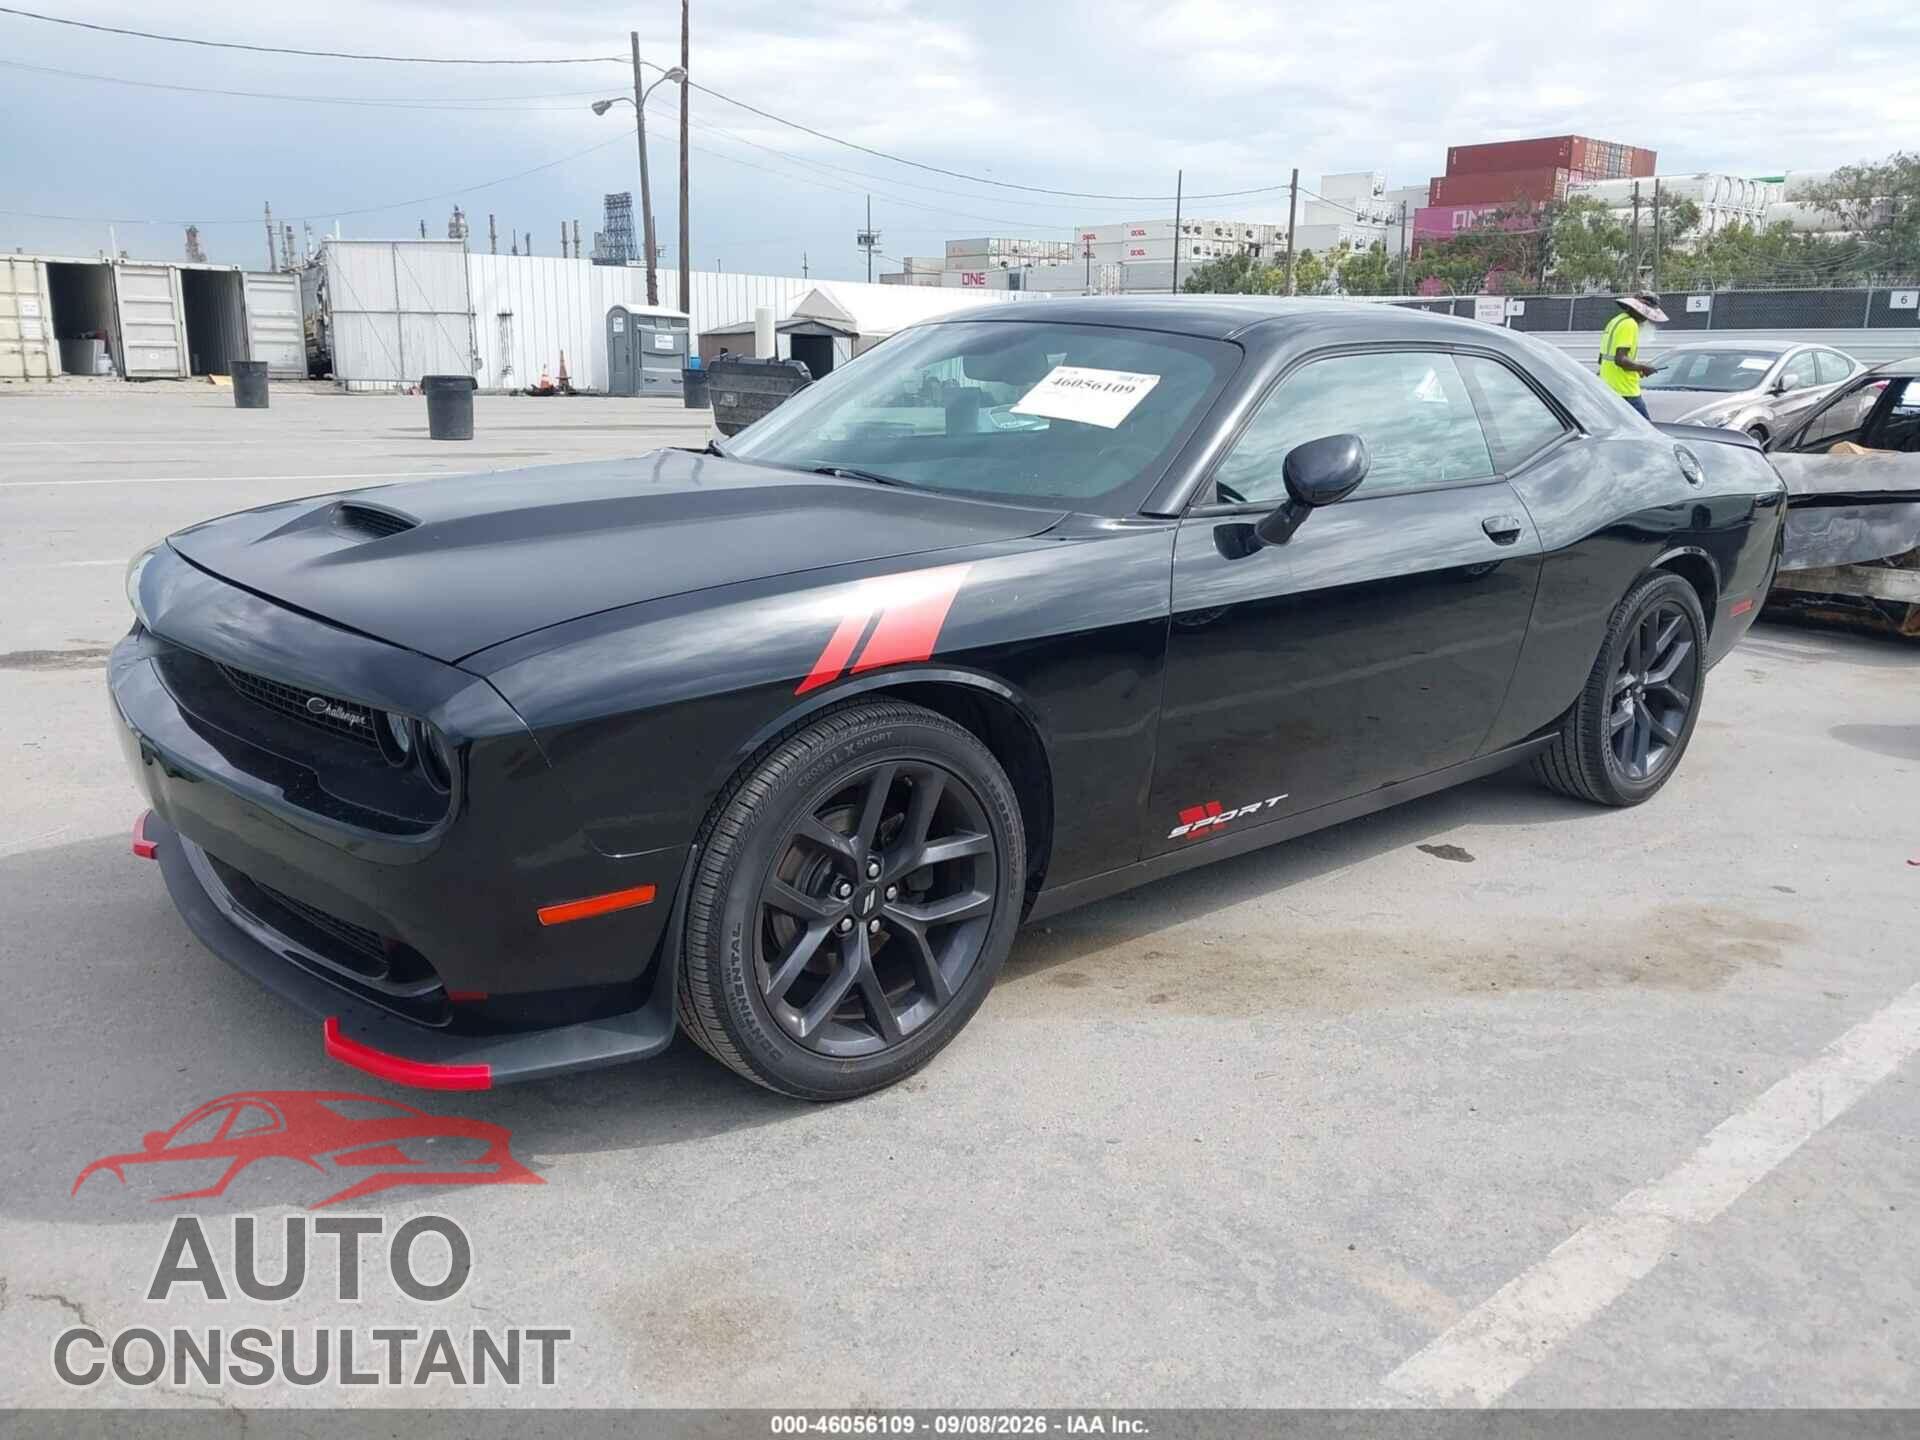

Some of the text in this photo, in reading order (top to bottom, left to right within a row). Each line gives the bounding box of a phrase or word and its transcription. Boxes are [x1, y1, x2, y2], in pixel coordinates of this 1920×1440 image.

[962, 272, 986, 286] ONE
[1695, 299, 1702, 309] 5
[1901, 295, 1908, 305] 6
[1050, 376, 1136, 394] 46056109
[1167, 793, 1289, 840] SPORT
